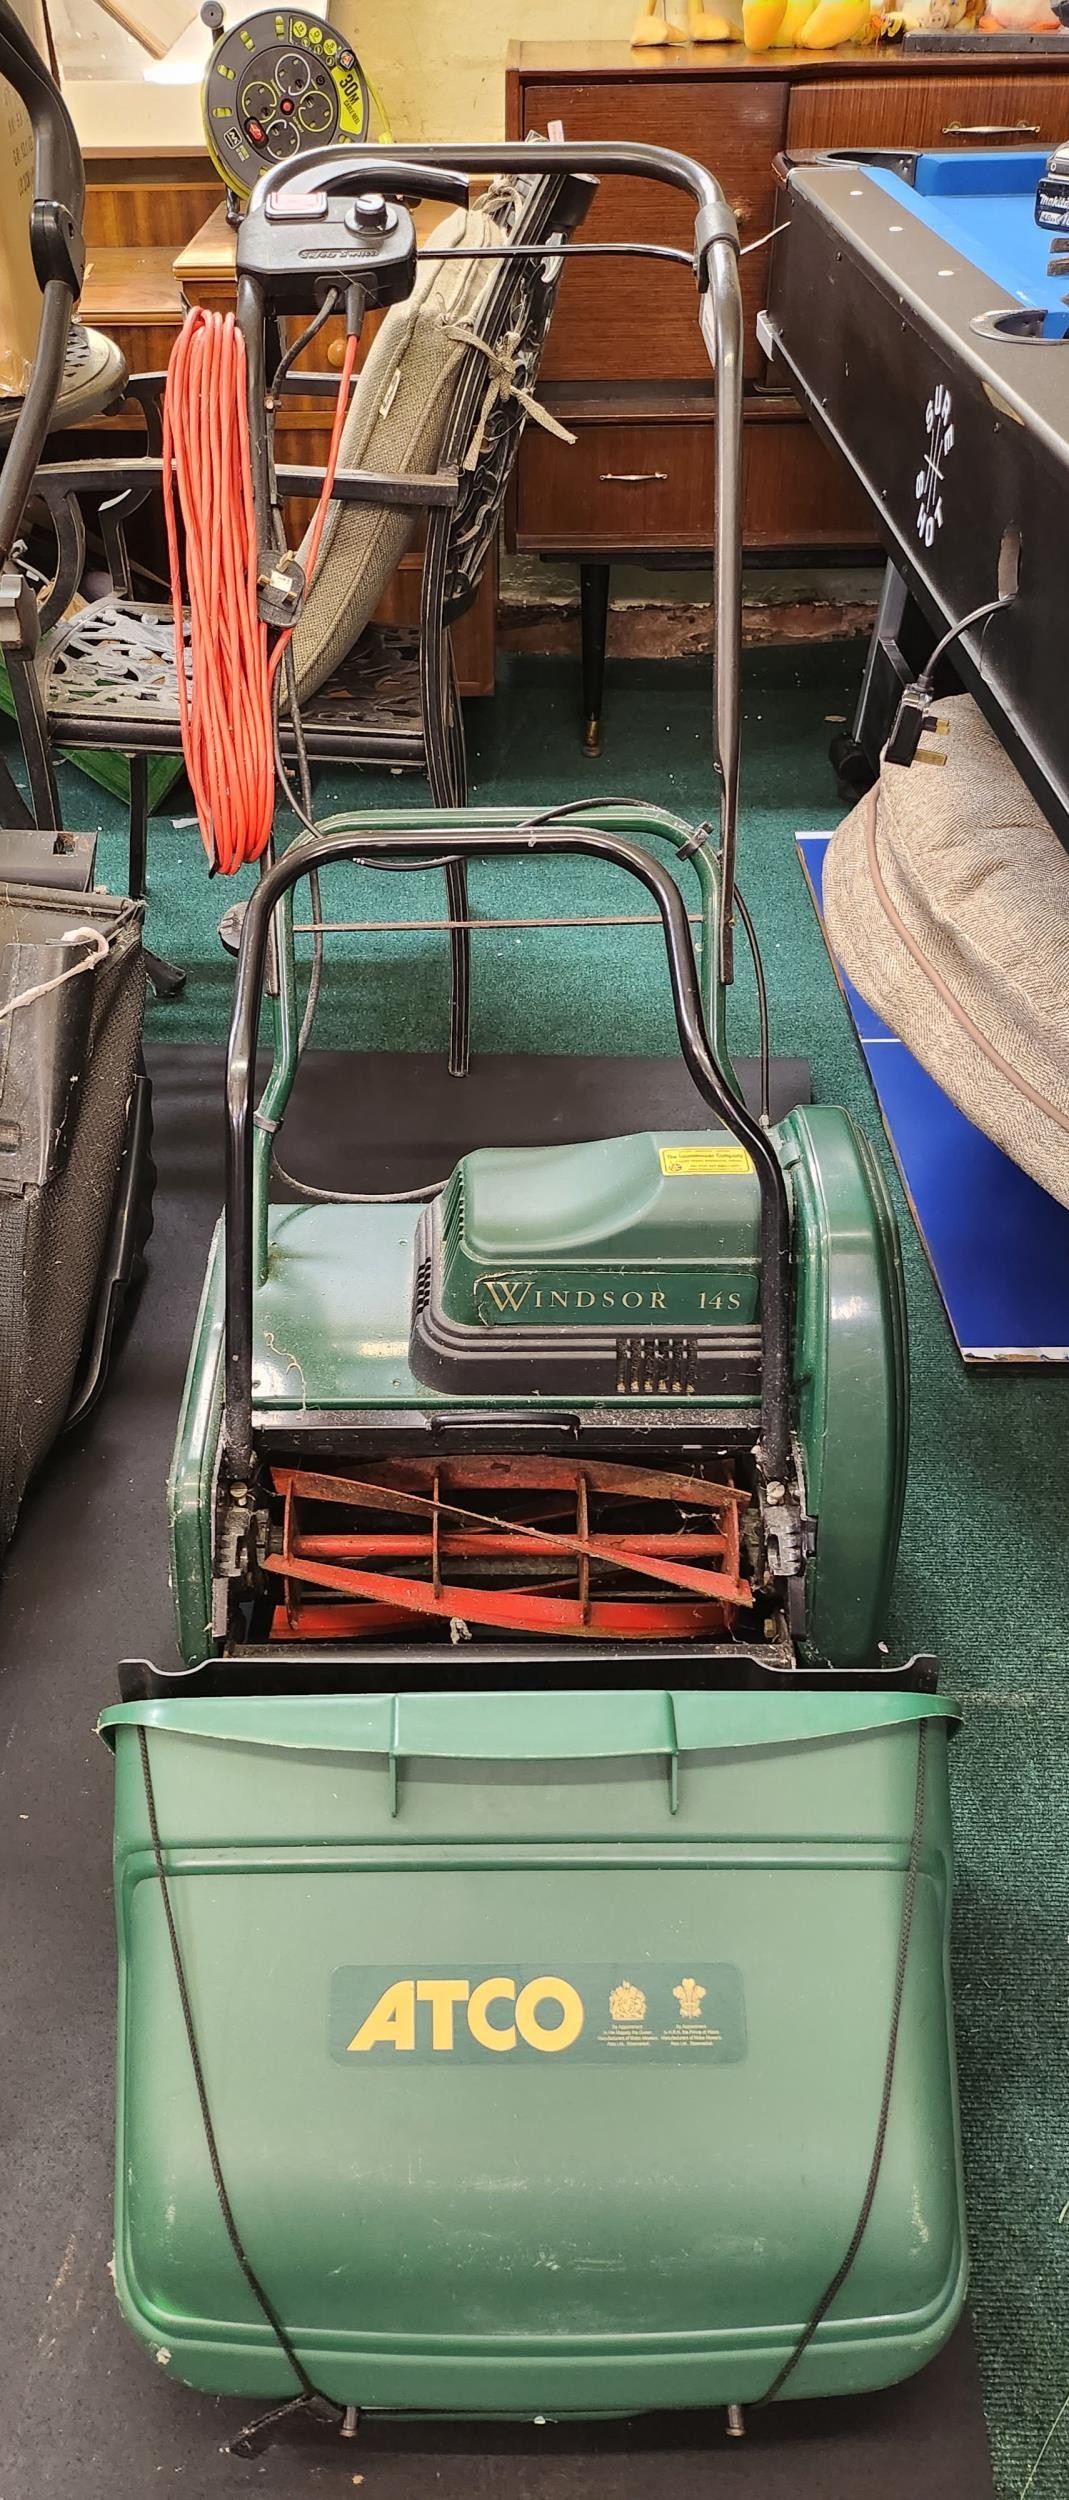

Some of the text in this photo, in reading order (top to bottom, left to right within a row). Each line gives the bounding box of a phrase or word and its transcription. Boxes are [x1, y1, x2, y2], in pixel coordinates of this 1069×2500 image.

[925, 383, 955, 457] SURE
[484, 1281, 741, 1312] WINDSOR 14S
[346, 1975, 585, 2053] ATCO
